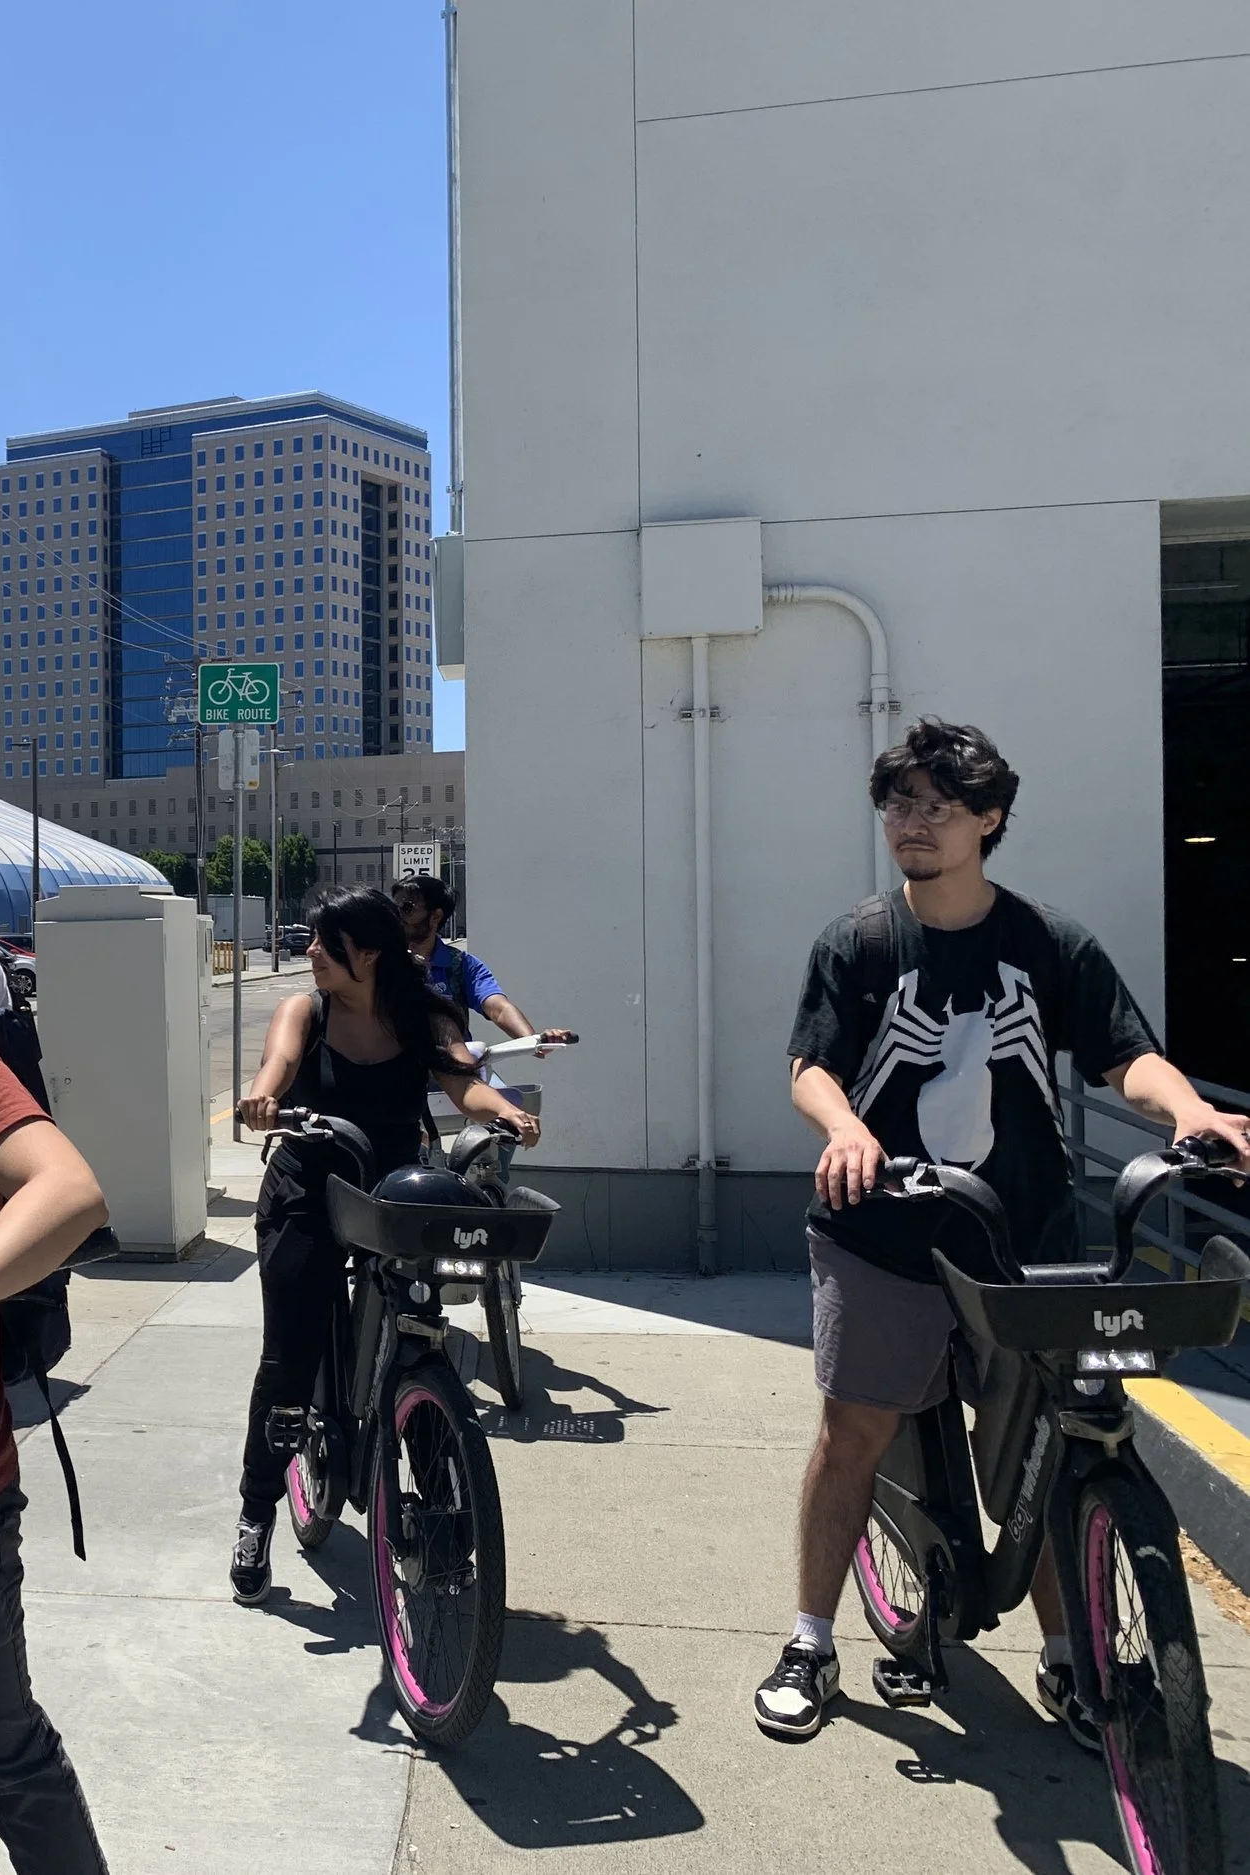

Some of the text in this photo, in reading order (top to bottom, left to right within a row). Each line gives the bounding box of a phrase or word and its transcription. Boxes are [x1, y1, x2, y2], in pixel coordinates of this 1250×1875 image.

[205, 708, 272, 721] BIKE ROUTE
[400, 847, 433, 855] SPEED
[403, 857, 430, 865] LIMIT
[453, 1227, 489, 1250] lyft
[1093, 1309, 1144, 1338] lyft
